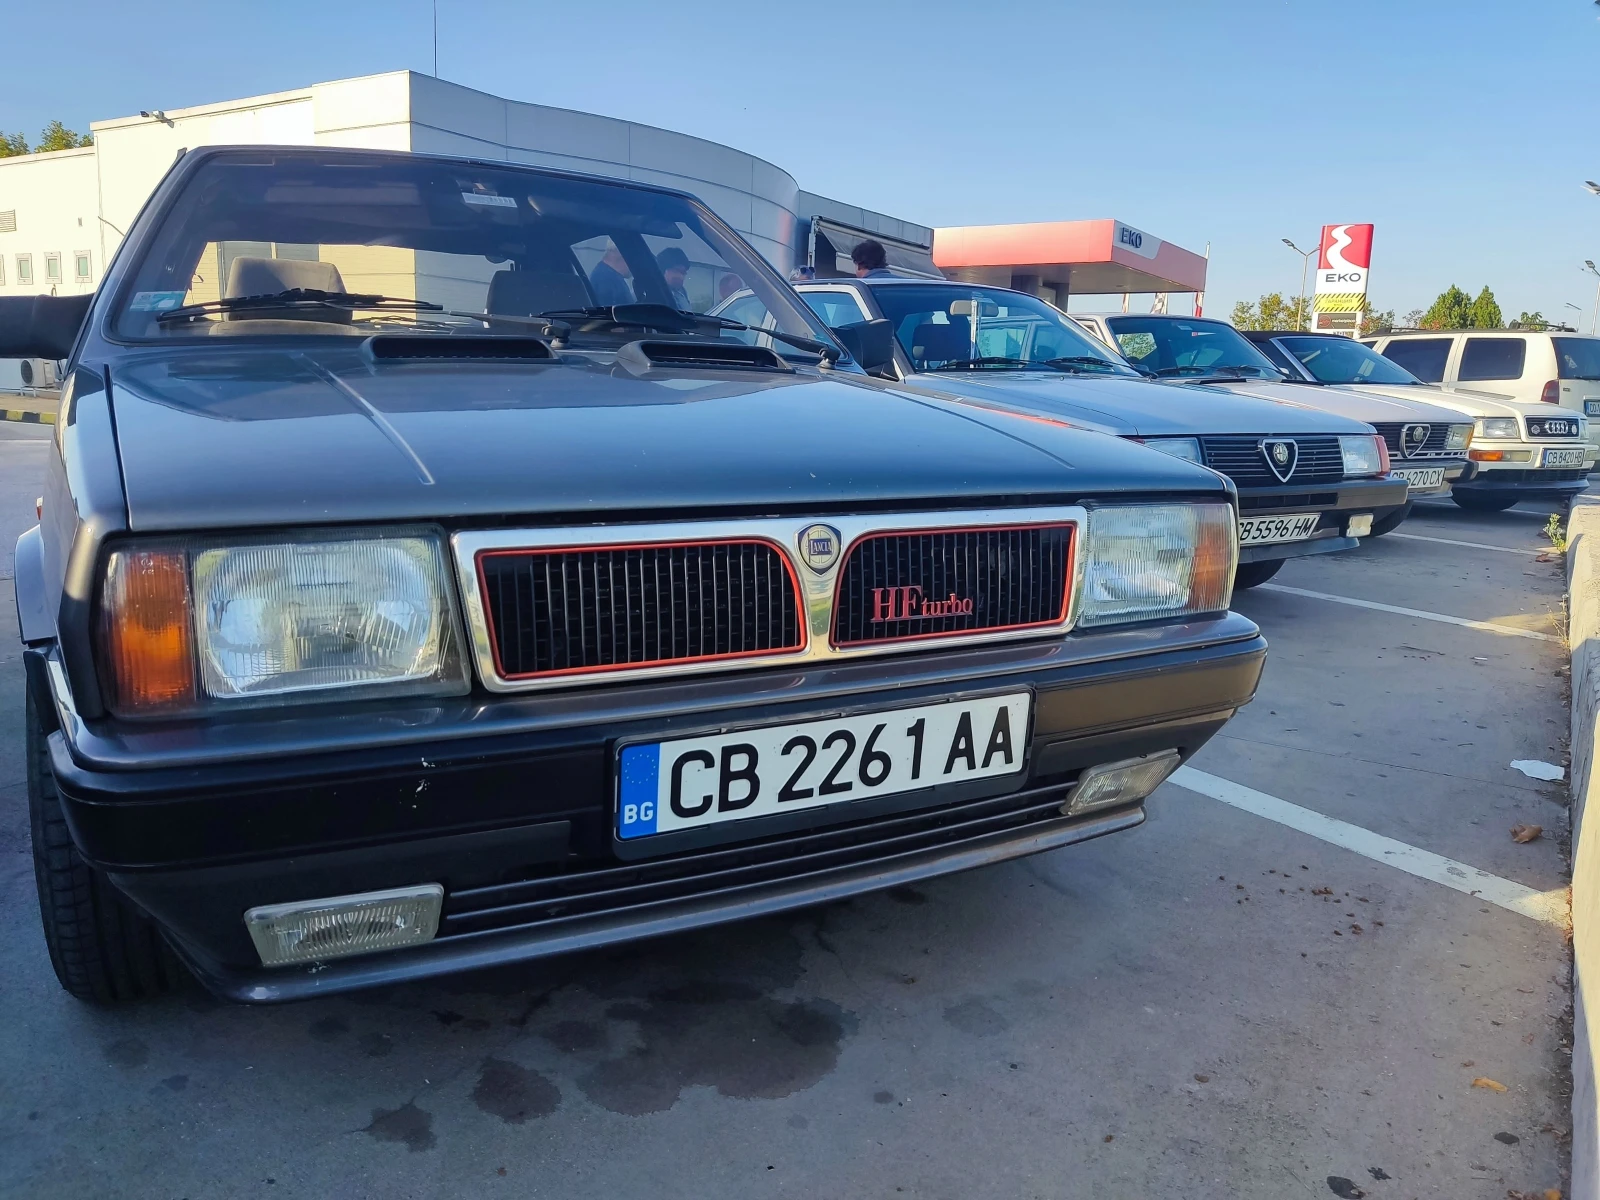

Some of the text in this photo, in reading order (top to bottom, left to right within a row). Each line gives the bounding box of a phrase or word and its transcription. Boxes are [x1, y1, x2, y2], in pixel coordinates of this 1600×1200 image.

[1120, 227, 1142, 248] EKO
[1325, 273, 1361, 282] EKO
[1430, 469, 1443, 485] CX
[1251, 518, 1292, 540] 5596
[1289, 517, 1316, 537] HM
[810, 540, 832, 555] LANCIA
[870, 585, 973, 623] HF turbo
[670, 705, 1013, 819] CB 2261 AA
[624, 801, 654, 825] BG
